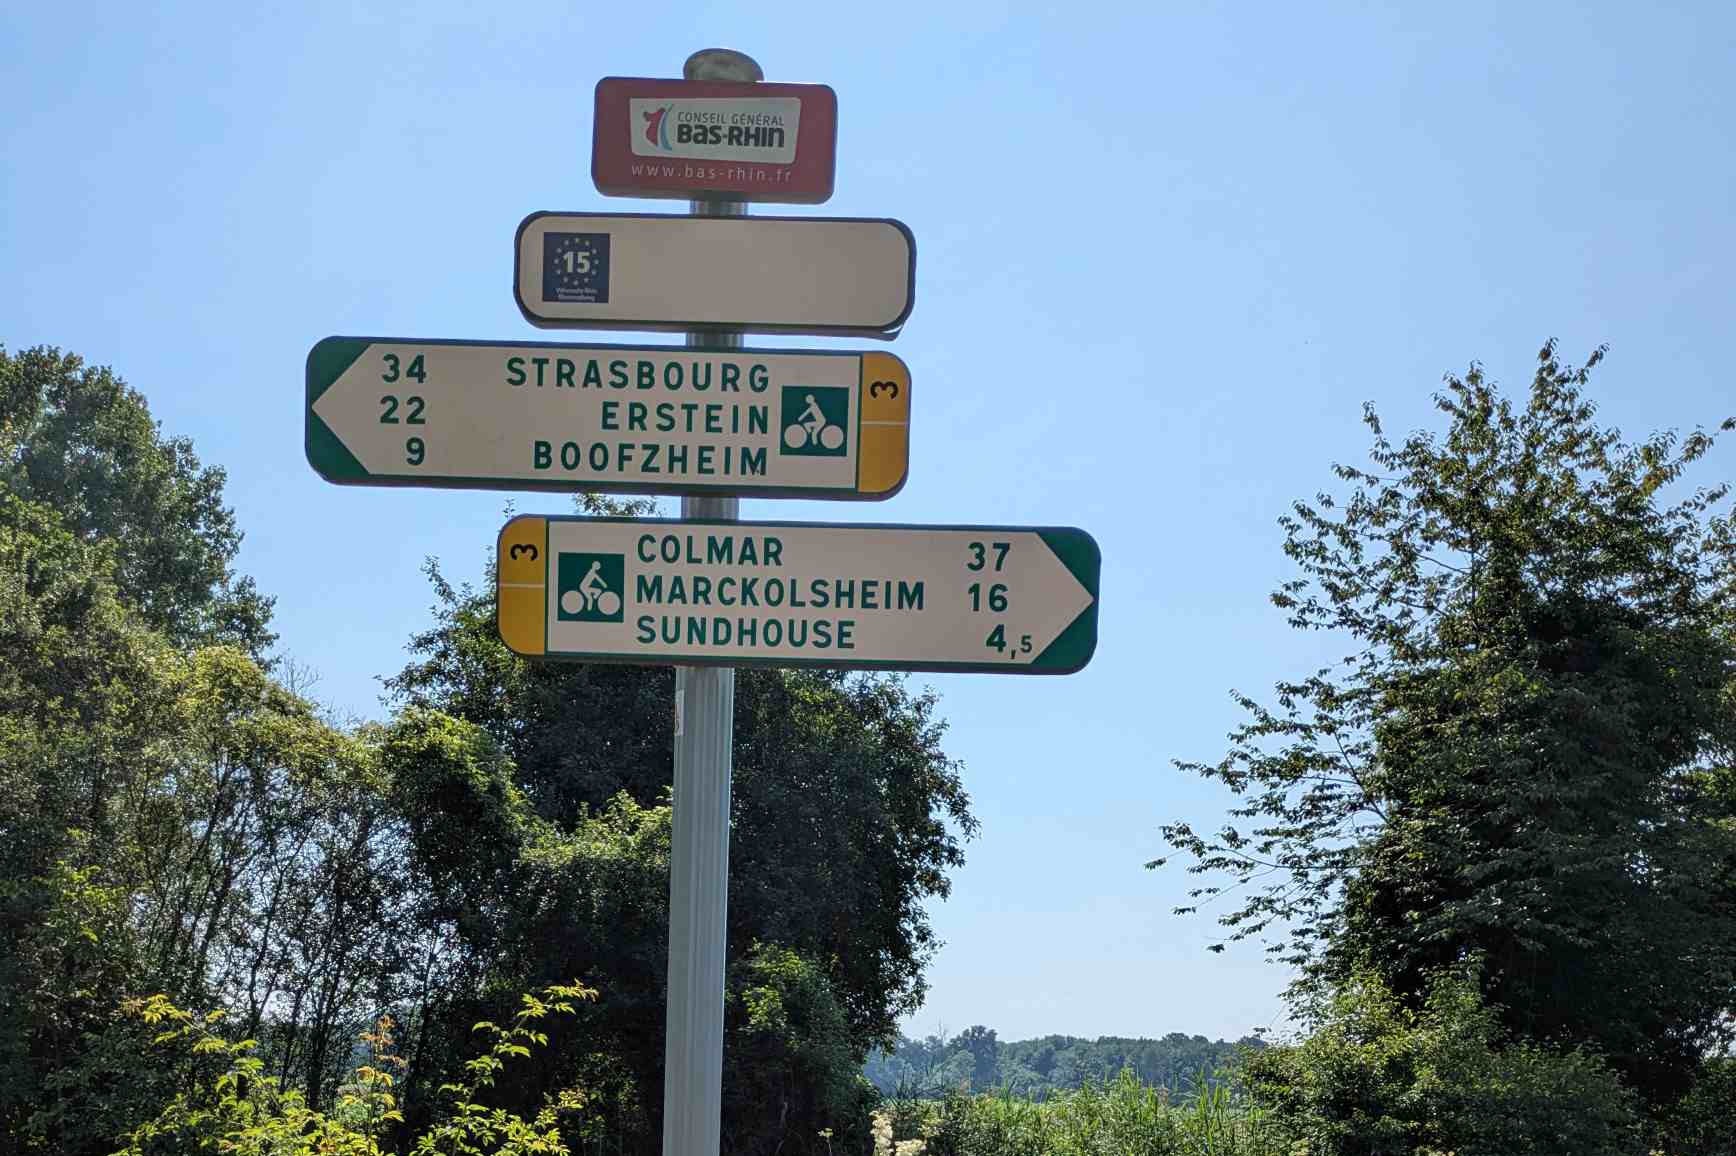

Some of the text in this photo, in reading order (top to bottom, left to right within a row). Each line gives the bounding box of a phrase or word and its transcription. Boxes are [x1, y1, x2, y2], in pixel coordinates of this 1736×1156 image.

[677, 111, 785, 127] CONSEIL GÉNÉRAL
[630, 163, 792, 182] www.bas-rhin.fr
[562, 250, 591, 274] 15
[380, 353, 770, 394] 34 STRASBOURG
[869, 380, 899, 400] 3
[379, 395, 769, 435] 22 ERSTEIN
[406, 436, 768, 477] 9 BOOFZHEIM
[509, 543, 539, 562] 3
[637, 533, 1011, 572] COLMAR 37
[636, 574, 1009, 613] MARCKOLSHEIM 16
[636, 615, 856, 650] SUNDHOUSE
